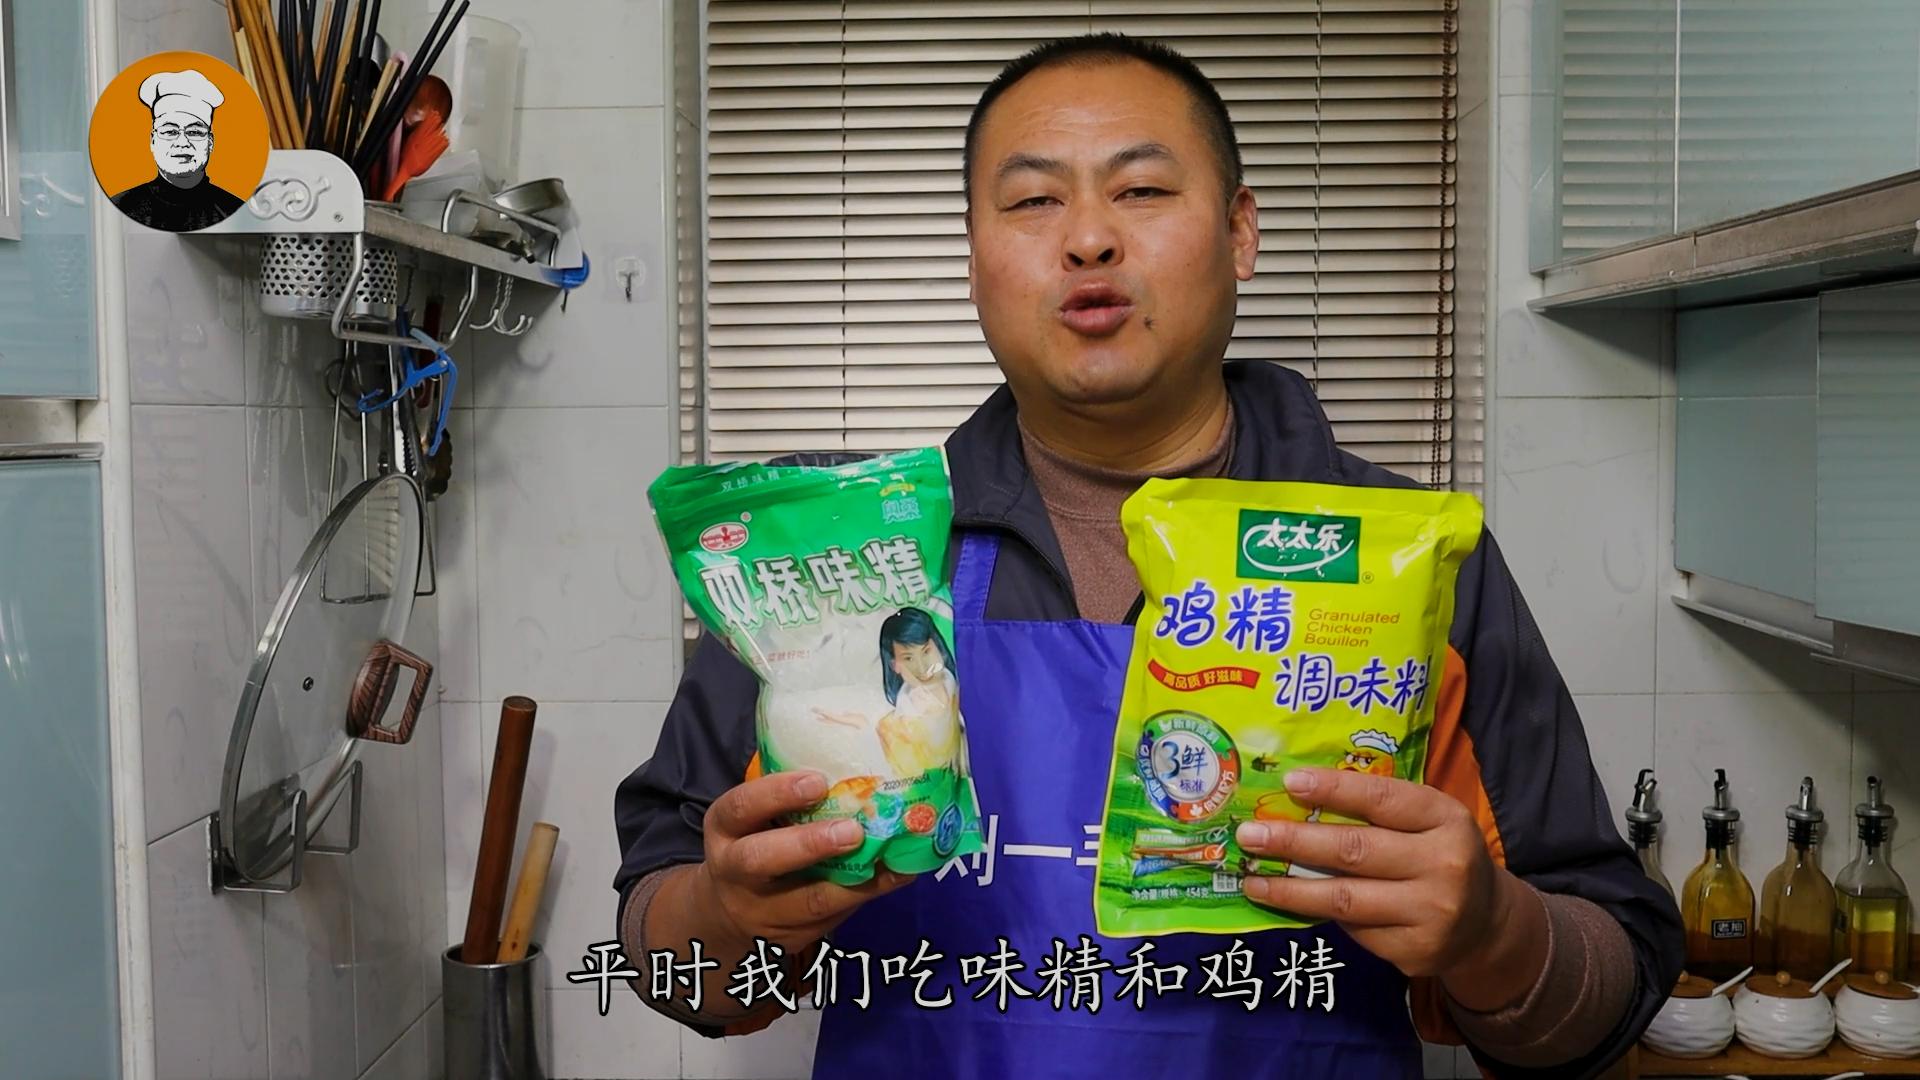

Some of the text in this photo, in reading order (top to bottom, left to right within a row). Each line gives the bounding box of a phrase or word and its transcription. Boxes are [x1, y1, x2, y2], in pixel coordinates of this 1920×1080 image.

[720, 469, 780, 493] 双桥味精
[1255, 517, 1345, 552] 太太乐
[699, 537, 933, 631] 双桥味精
[1154, 581, 1293, 653] 鸡精
[1306, 621, 1374, 635] Chicken
[1308, 608, 1401, 624] Granulated
[1303, 632, 1369, 648] Bouillon
[1163, 669, 1243, 689] 高品质 好滋味
[1274, 653, 1432, 715] 调味料
[1160, 740, 1209, 780] 3鲜
[1180, 779, 1205, 794] 标准
